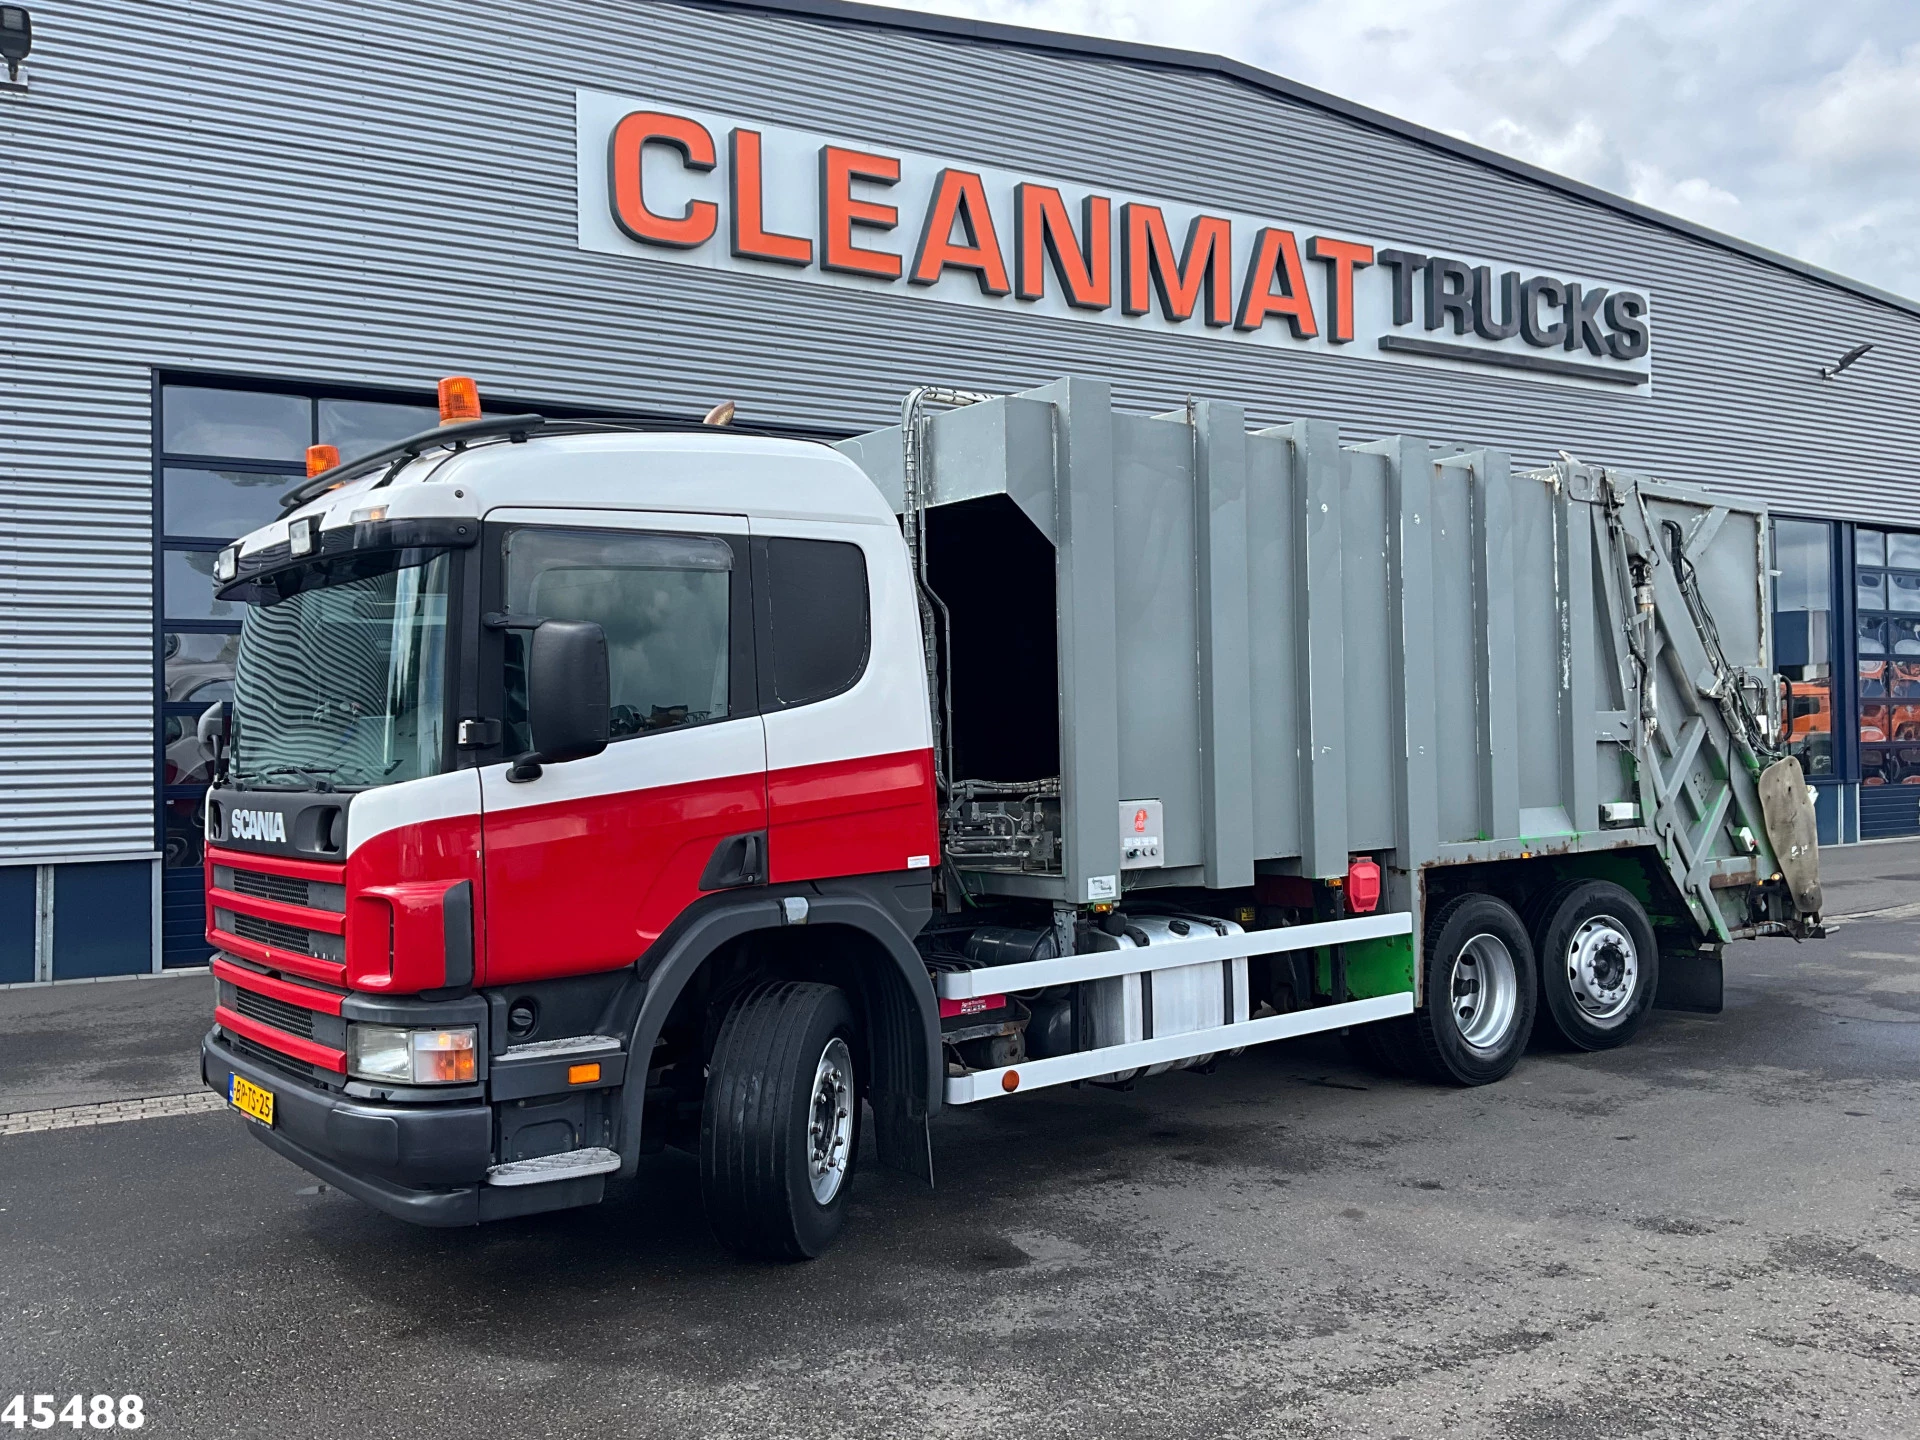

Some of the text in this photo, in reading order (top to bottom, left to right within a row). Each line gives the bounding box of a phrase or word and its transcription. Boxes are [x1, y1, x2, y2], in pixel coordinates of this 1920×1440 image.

[608, 110, 1649, 361] CLEANMAT TRUCKS
[231, 808, 286, 843] SCANIA
[235, 1080, 270, 1118] BP-TS-25
